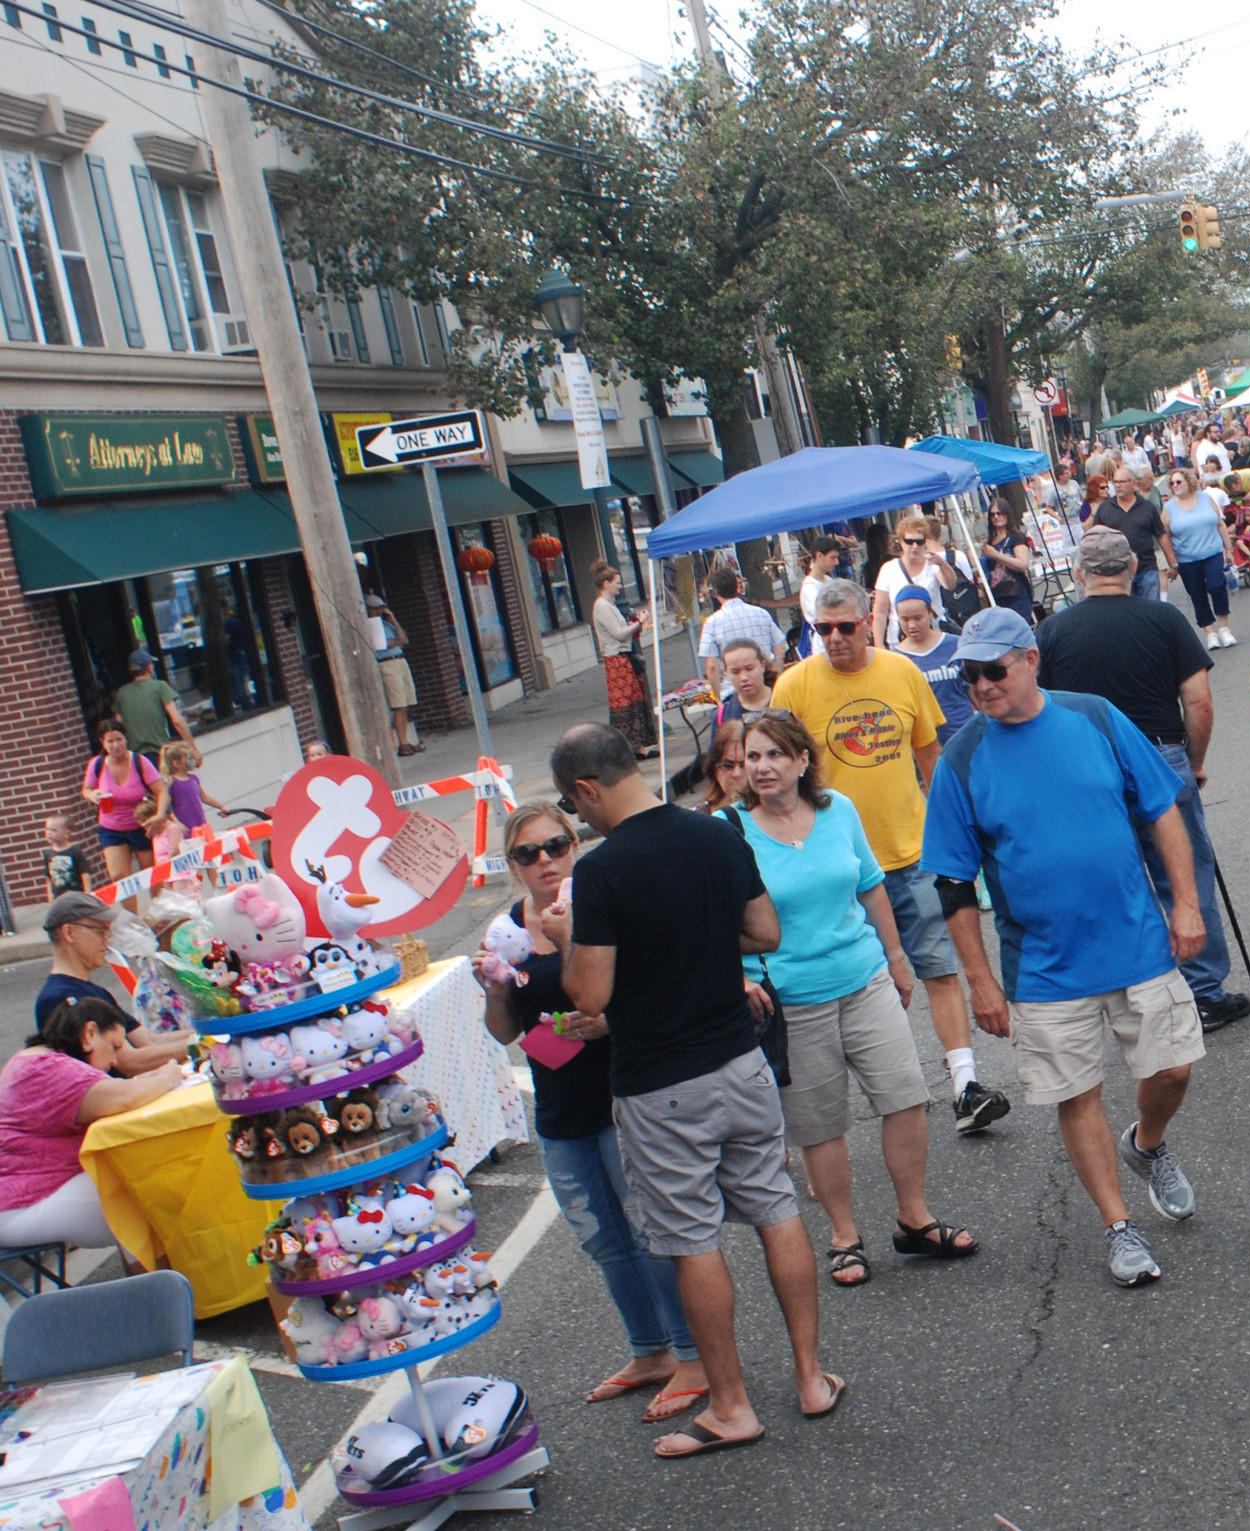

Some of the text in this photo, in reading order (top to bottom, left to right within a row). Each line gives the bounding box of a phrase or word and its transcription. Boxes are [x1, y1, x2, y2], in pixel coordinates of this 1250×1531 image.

[89, 430, 204, 476] Attorneys at Law
[396, 424, 468, 451] ONE WAY
